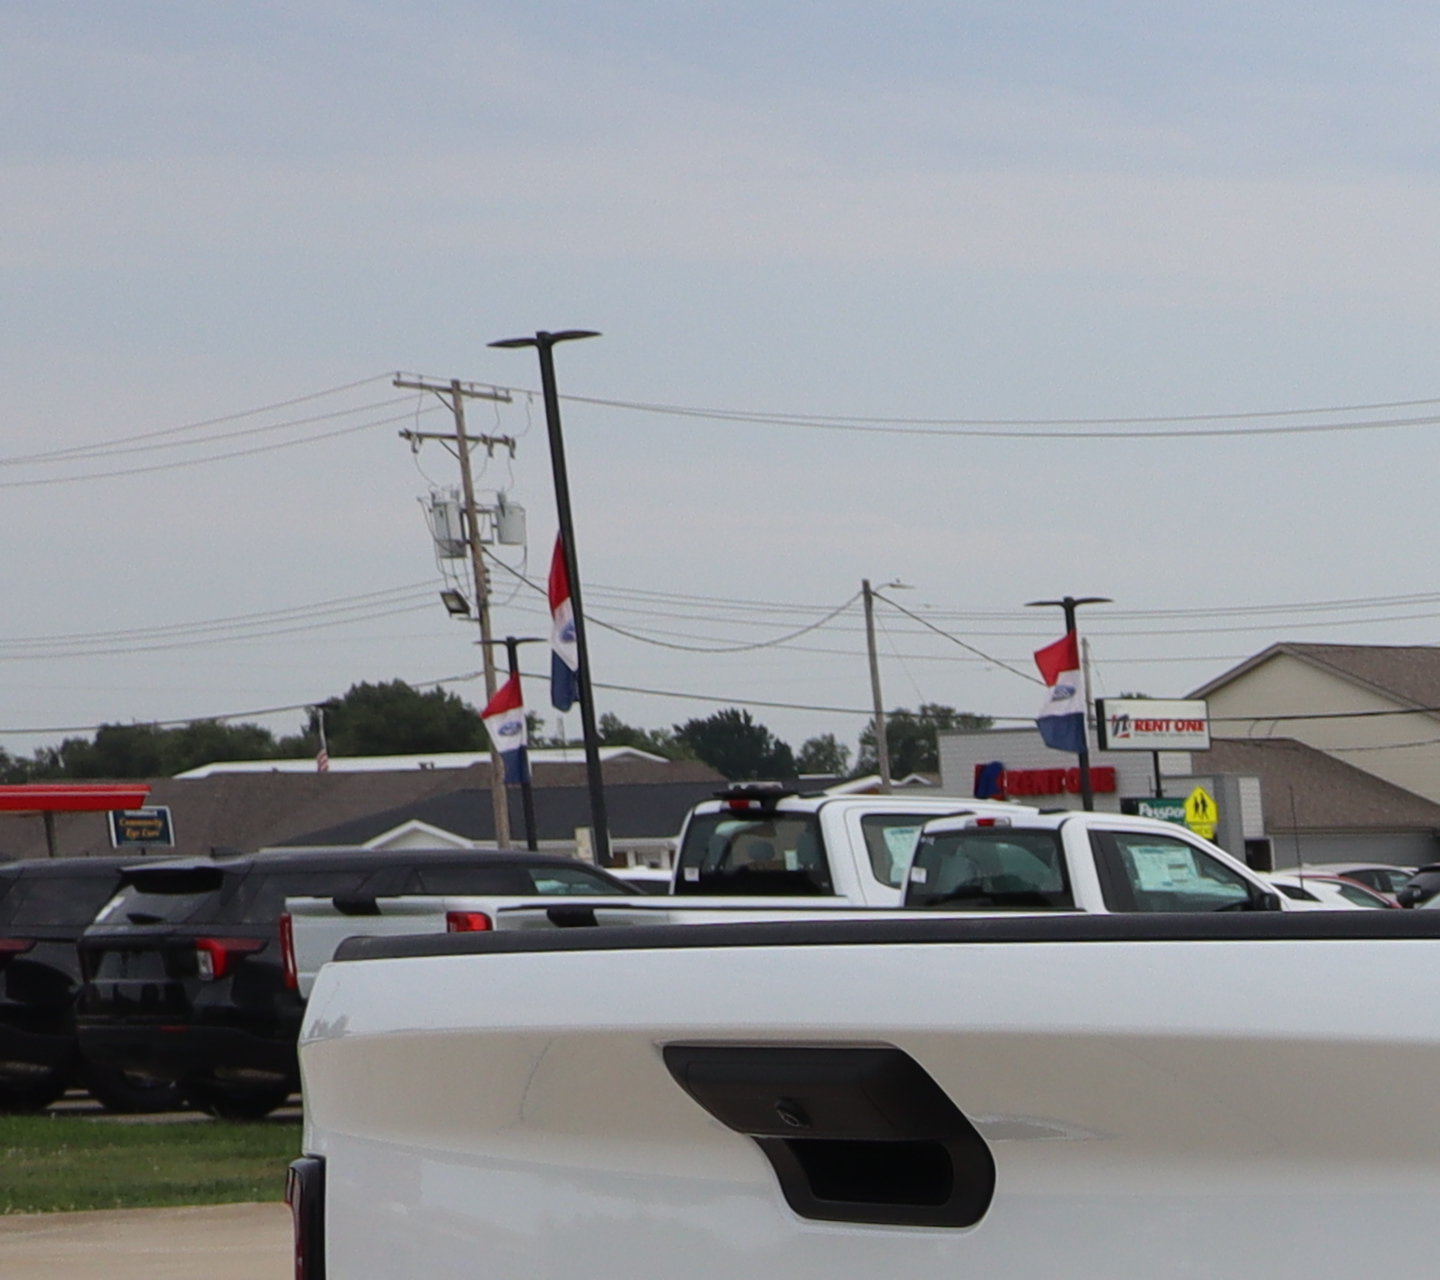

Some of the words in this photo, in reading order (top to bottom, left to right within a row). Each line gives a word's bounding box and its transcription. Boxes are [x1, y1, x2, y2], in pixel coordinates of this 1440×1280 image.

[1134, 718, 1170, 732] RENT
[1174, 718, 1205, 732] ONE
[1138, 802, 1185, 819] Passpor
